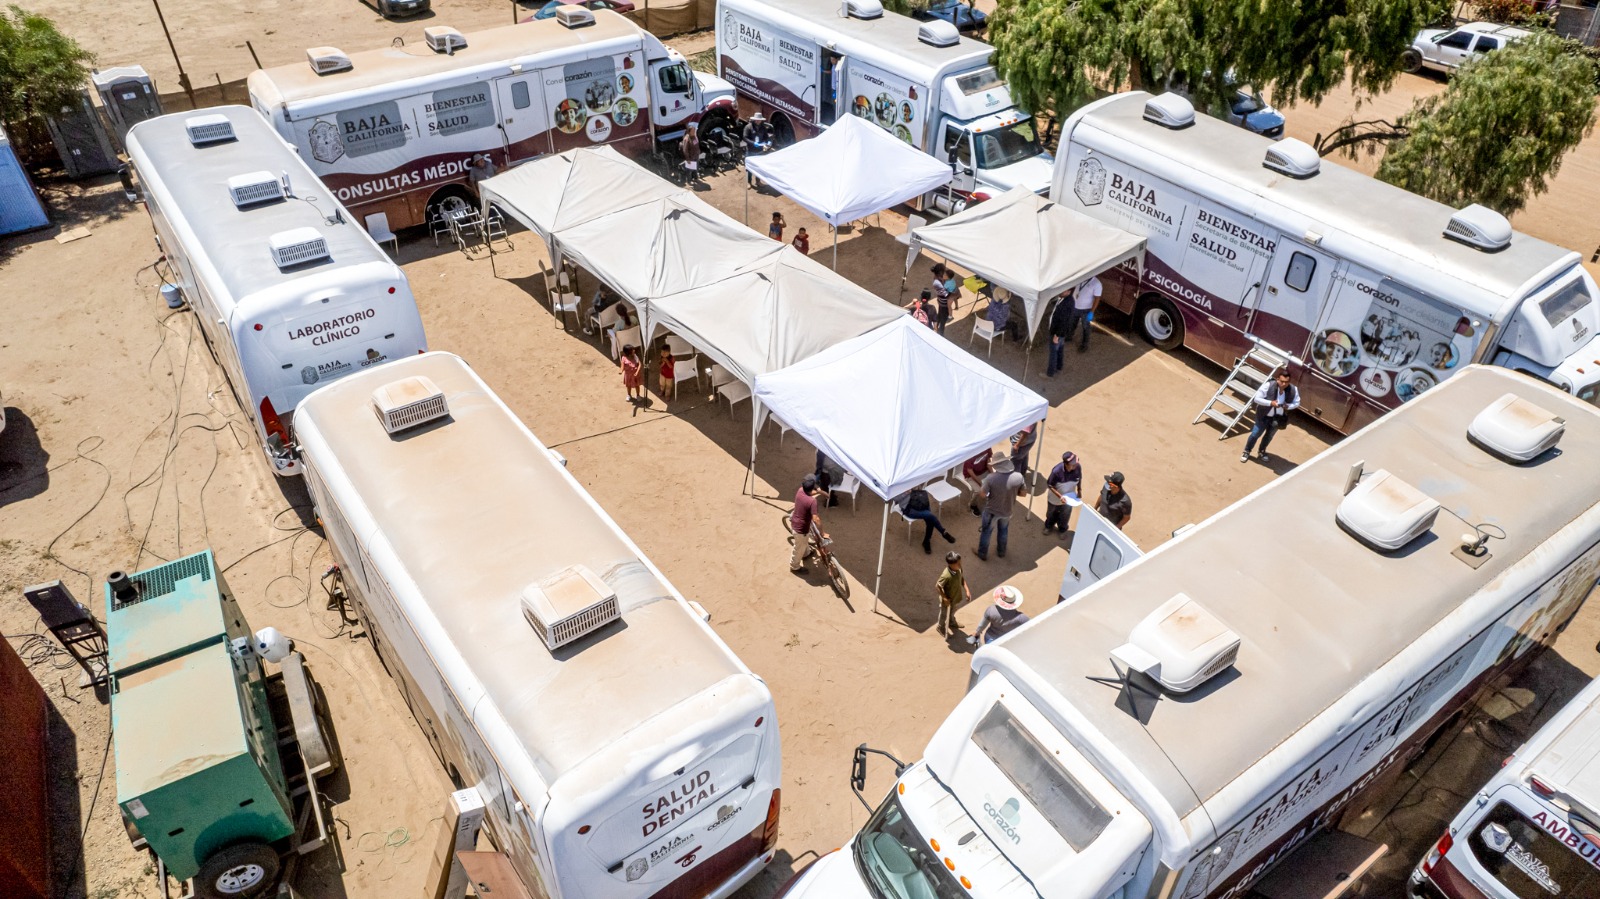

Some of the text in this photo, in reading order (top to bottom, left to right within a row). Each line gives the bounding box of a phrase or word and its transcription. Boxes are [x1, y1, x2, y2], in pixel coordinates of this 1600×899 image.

[739, 23, 762, 42] BAJA
[739, 36, 771, 54] CALIFORNIA
[779, 39, 814, 60] BIENESTAR
[778, 55, 802, 72] SALUD
[564, 70, 593, 82] corazón
[424, 93, 486, 113] BIENESTAR
[343, 113, 390, 134] BAJA
[346, 123, 411, 143] CALIFORNIA
[428, 115, 469, 132] SALUD
[332, 153, 493, 201] ONSULTAS MÉDICS
[1110, 173, 1157, 206] BAJA
[1108, 189, 1173, 226] CALIFORNIA
[1197, 209, 1277, 254] BIENESTAR
[1190, 232, 1237, 261] SALUD
[1229, 236, 1239, 245] de
[1239, 241, 1274, 260] Bienestar
[1218, 256, 1227, 264] de
[1226, 260, 1245, 273] Salud
[1148, 270, 1212, 311] PSICOLOGÍA
[1330, 270, 1347, 284] Con
[1347, 278, 1356, 287] el
[1356, 281, 1401, 308] corazón
[288, 308, 375, 341] LABORATORIO
[311, 325, 361, 347] CLÍNICO
[317, 359, 342, 371] BAJA
[360, 354, 388, 367] corazón
[1364, 377, 1387, 392] corazón
[642, 770, 711, 820] SALUD
[1248, 767, 1321, 834] BAJA
[642, 783, 720, 838] DENTAL
[706, 806, 742, 832] corazón
[983, 802, 1022, 845] corazón
[650, 836, 682, 859] BAJA
